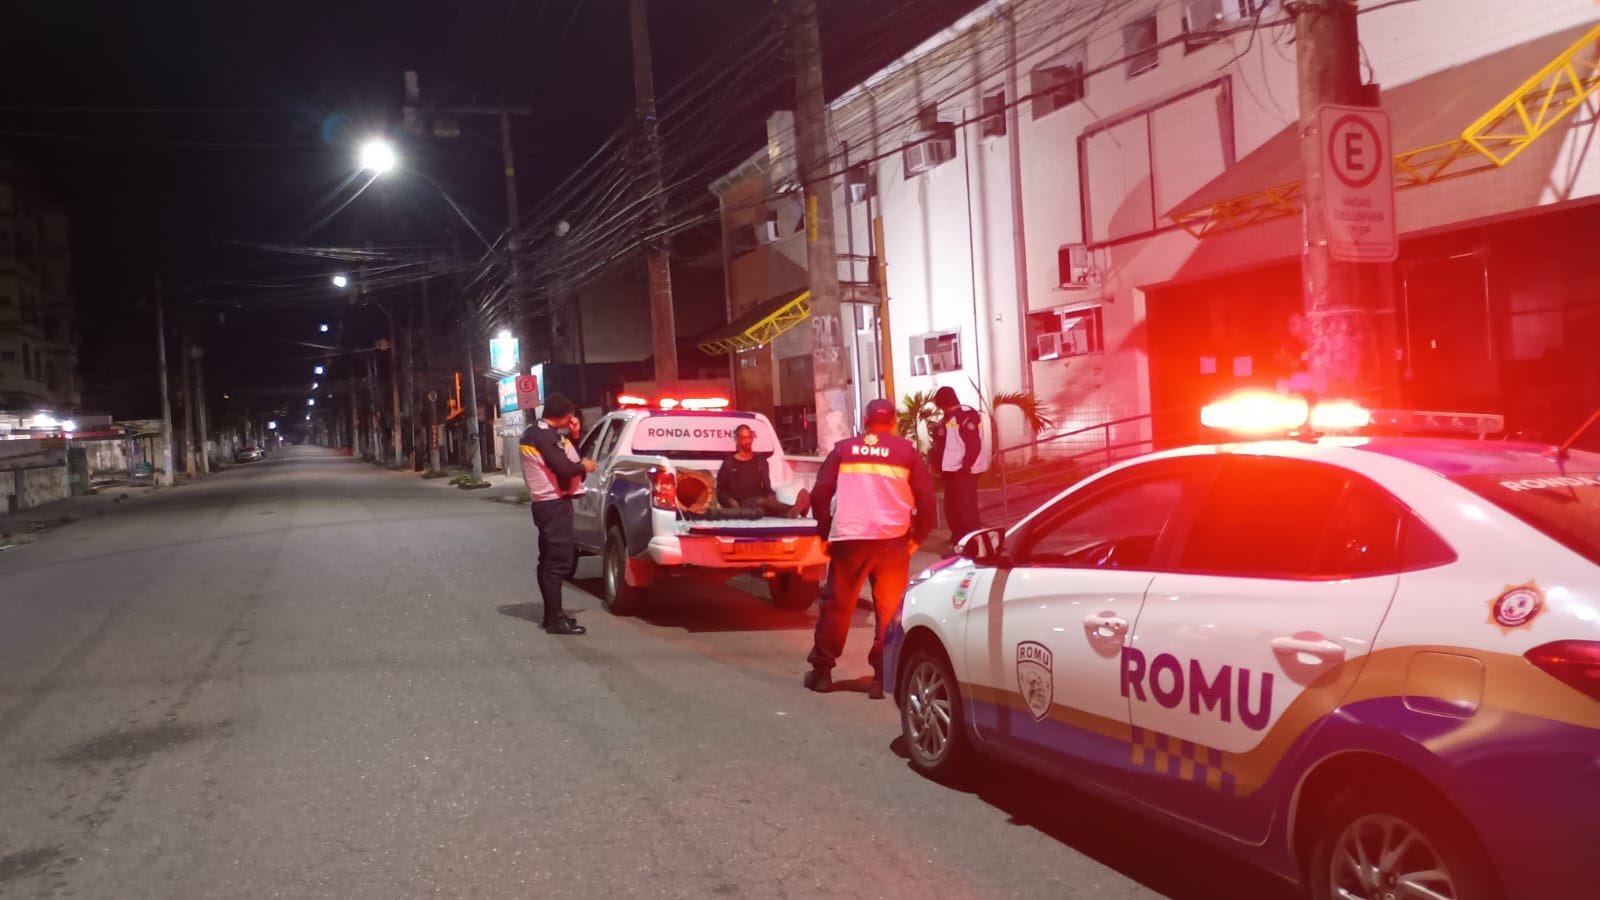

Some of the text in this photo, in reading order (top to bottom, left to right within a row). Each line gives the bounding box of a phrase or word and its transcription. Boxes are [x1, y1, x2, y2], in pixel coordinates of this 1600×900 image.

[1345, 132, 1364, 171] E
[647, 427, 691, 438] RONDA
[851, 445, 890, 458] ROMU
[1498, 475, 1600, 492] RONDA
[1019, 645, 1050, 666] ROMU
[1120, 646, 1275, 731] ROMU
